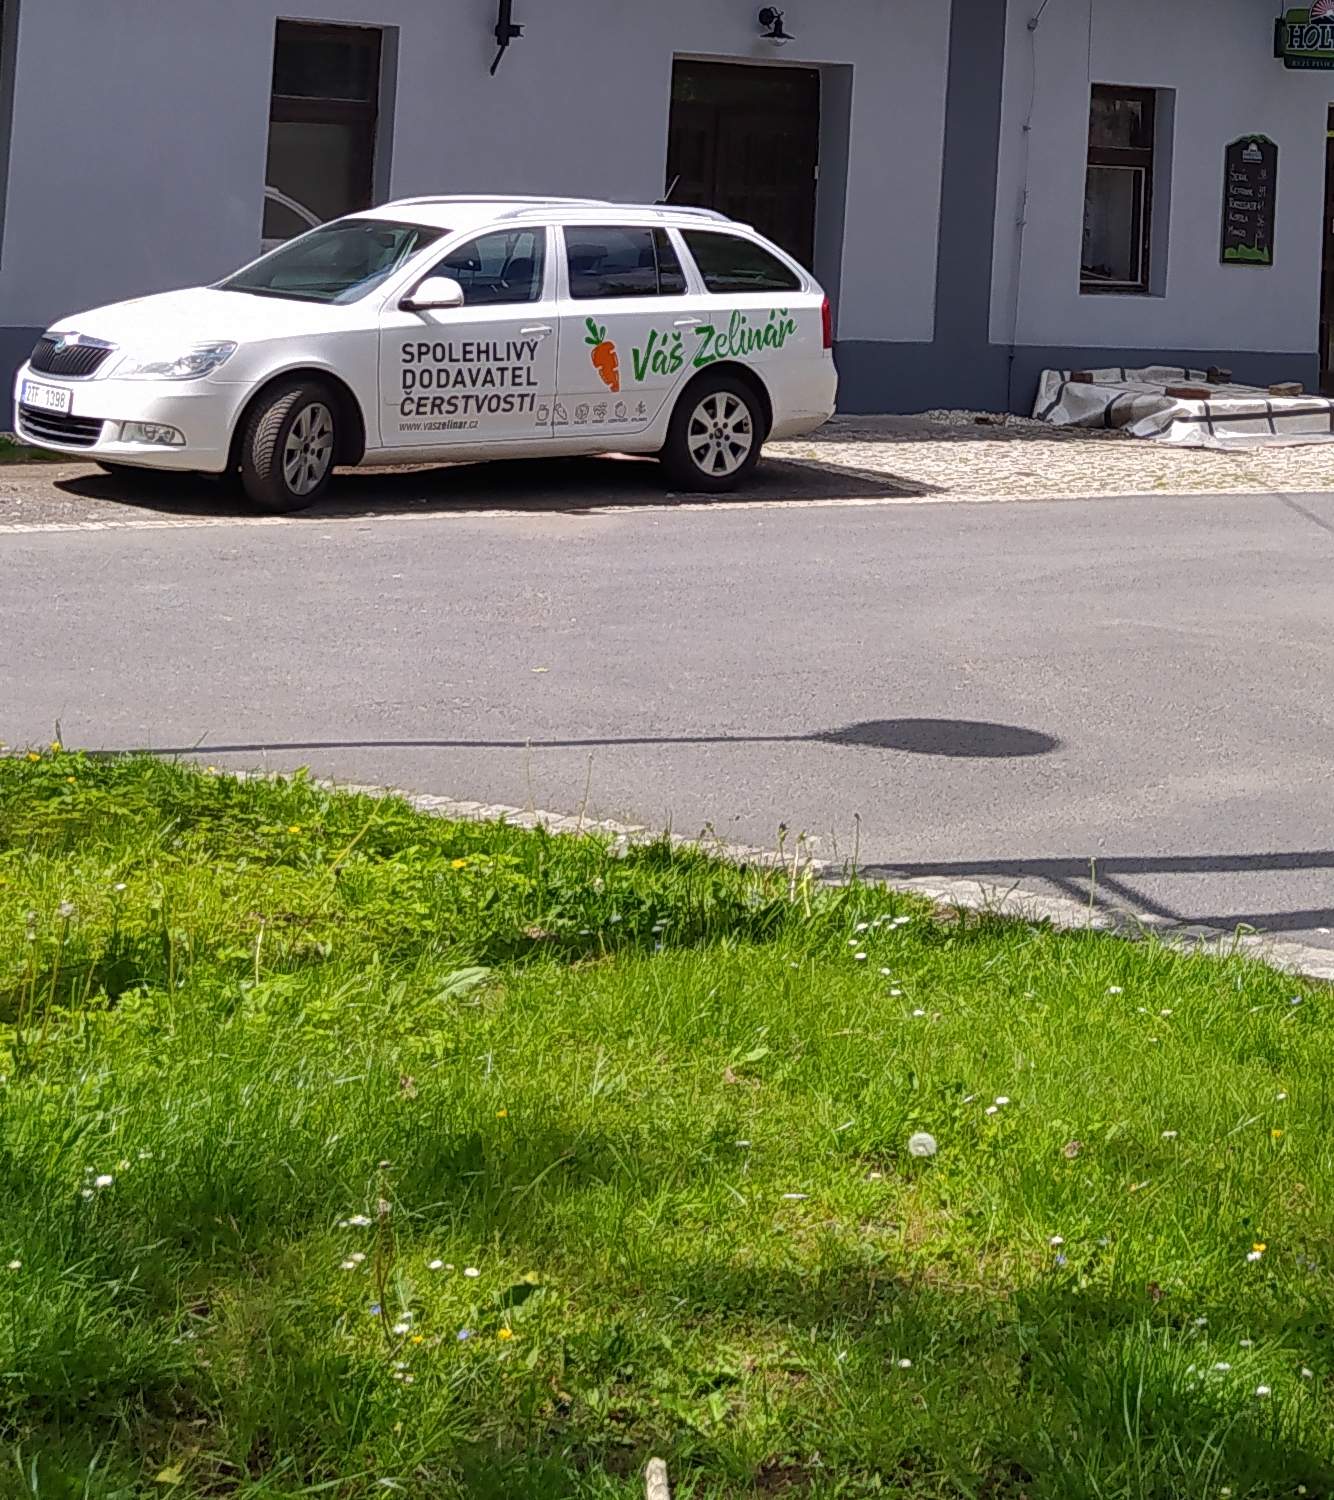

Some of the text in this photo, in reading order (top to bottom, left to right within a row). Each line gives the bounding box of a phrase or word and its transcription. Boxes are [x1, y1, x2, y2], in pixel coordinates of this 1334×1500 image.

[401, 339, 539, 364] SPOLEHLIVÝ
[632, 307, 798, 381] Váš Zelinář
[402, 366, 539, 390] DODAVATEL
[46, 389, 66, 409] 1398
[400, 390, 537, 416] ČERSTVOSTI
[398, 420, 479, 431] www.vaszelinar.cz
